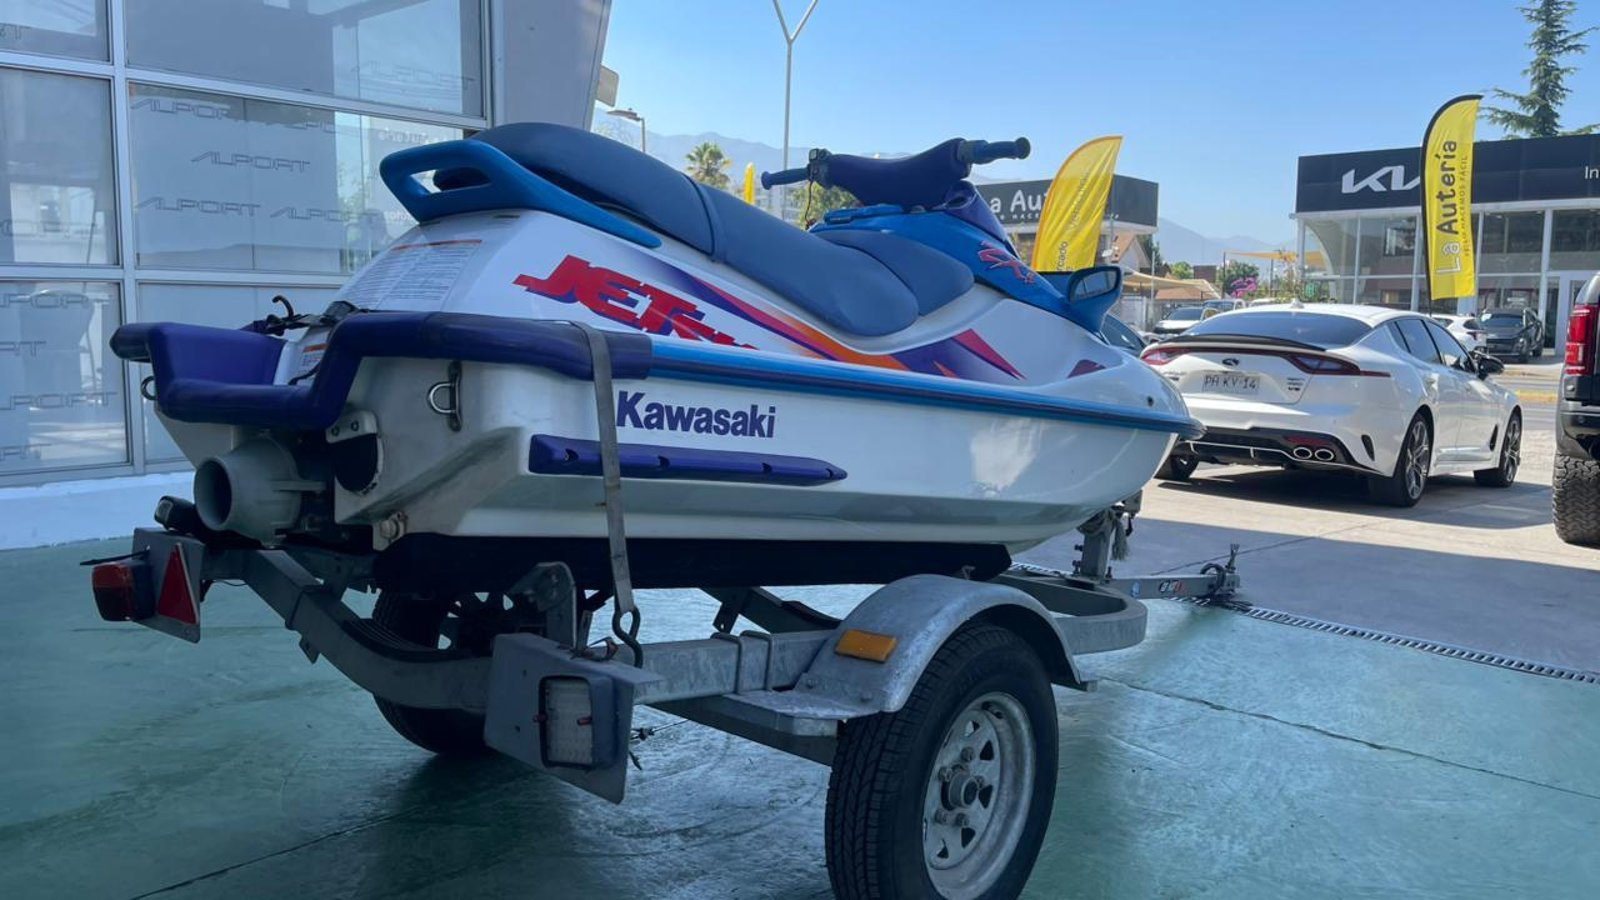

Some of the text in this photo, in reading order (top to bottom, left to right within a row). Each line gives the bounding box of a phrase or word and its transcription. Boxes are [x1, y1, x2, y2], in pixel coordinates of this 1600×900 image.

[989, 188, 1043, 213] a Au
[1433, 138, 1461, 274] La Autería
[1055, 240, 1069, 272] rcado
[616, 390, 776, 439] Kawasaki
